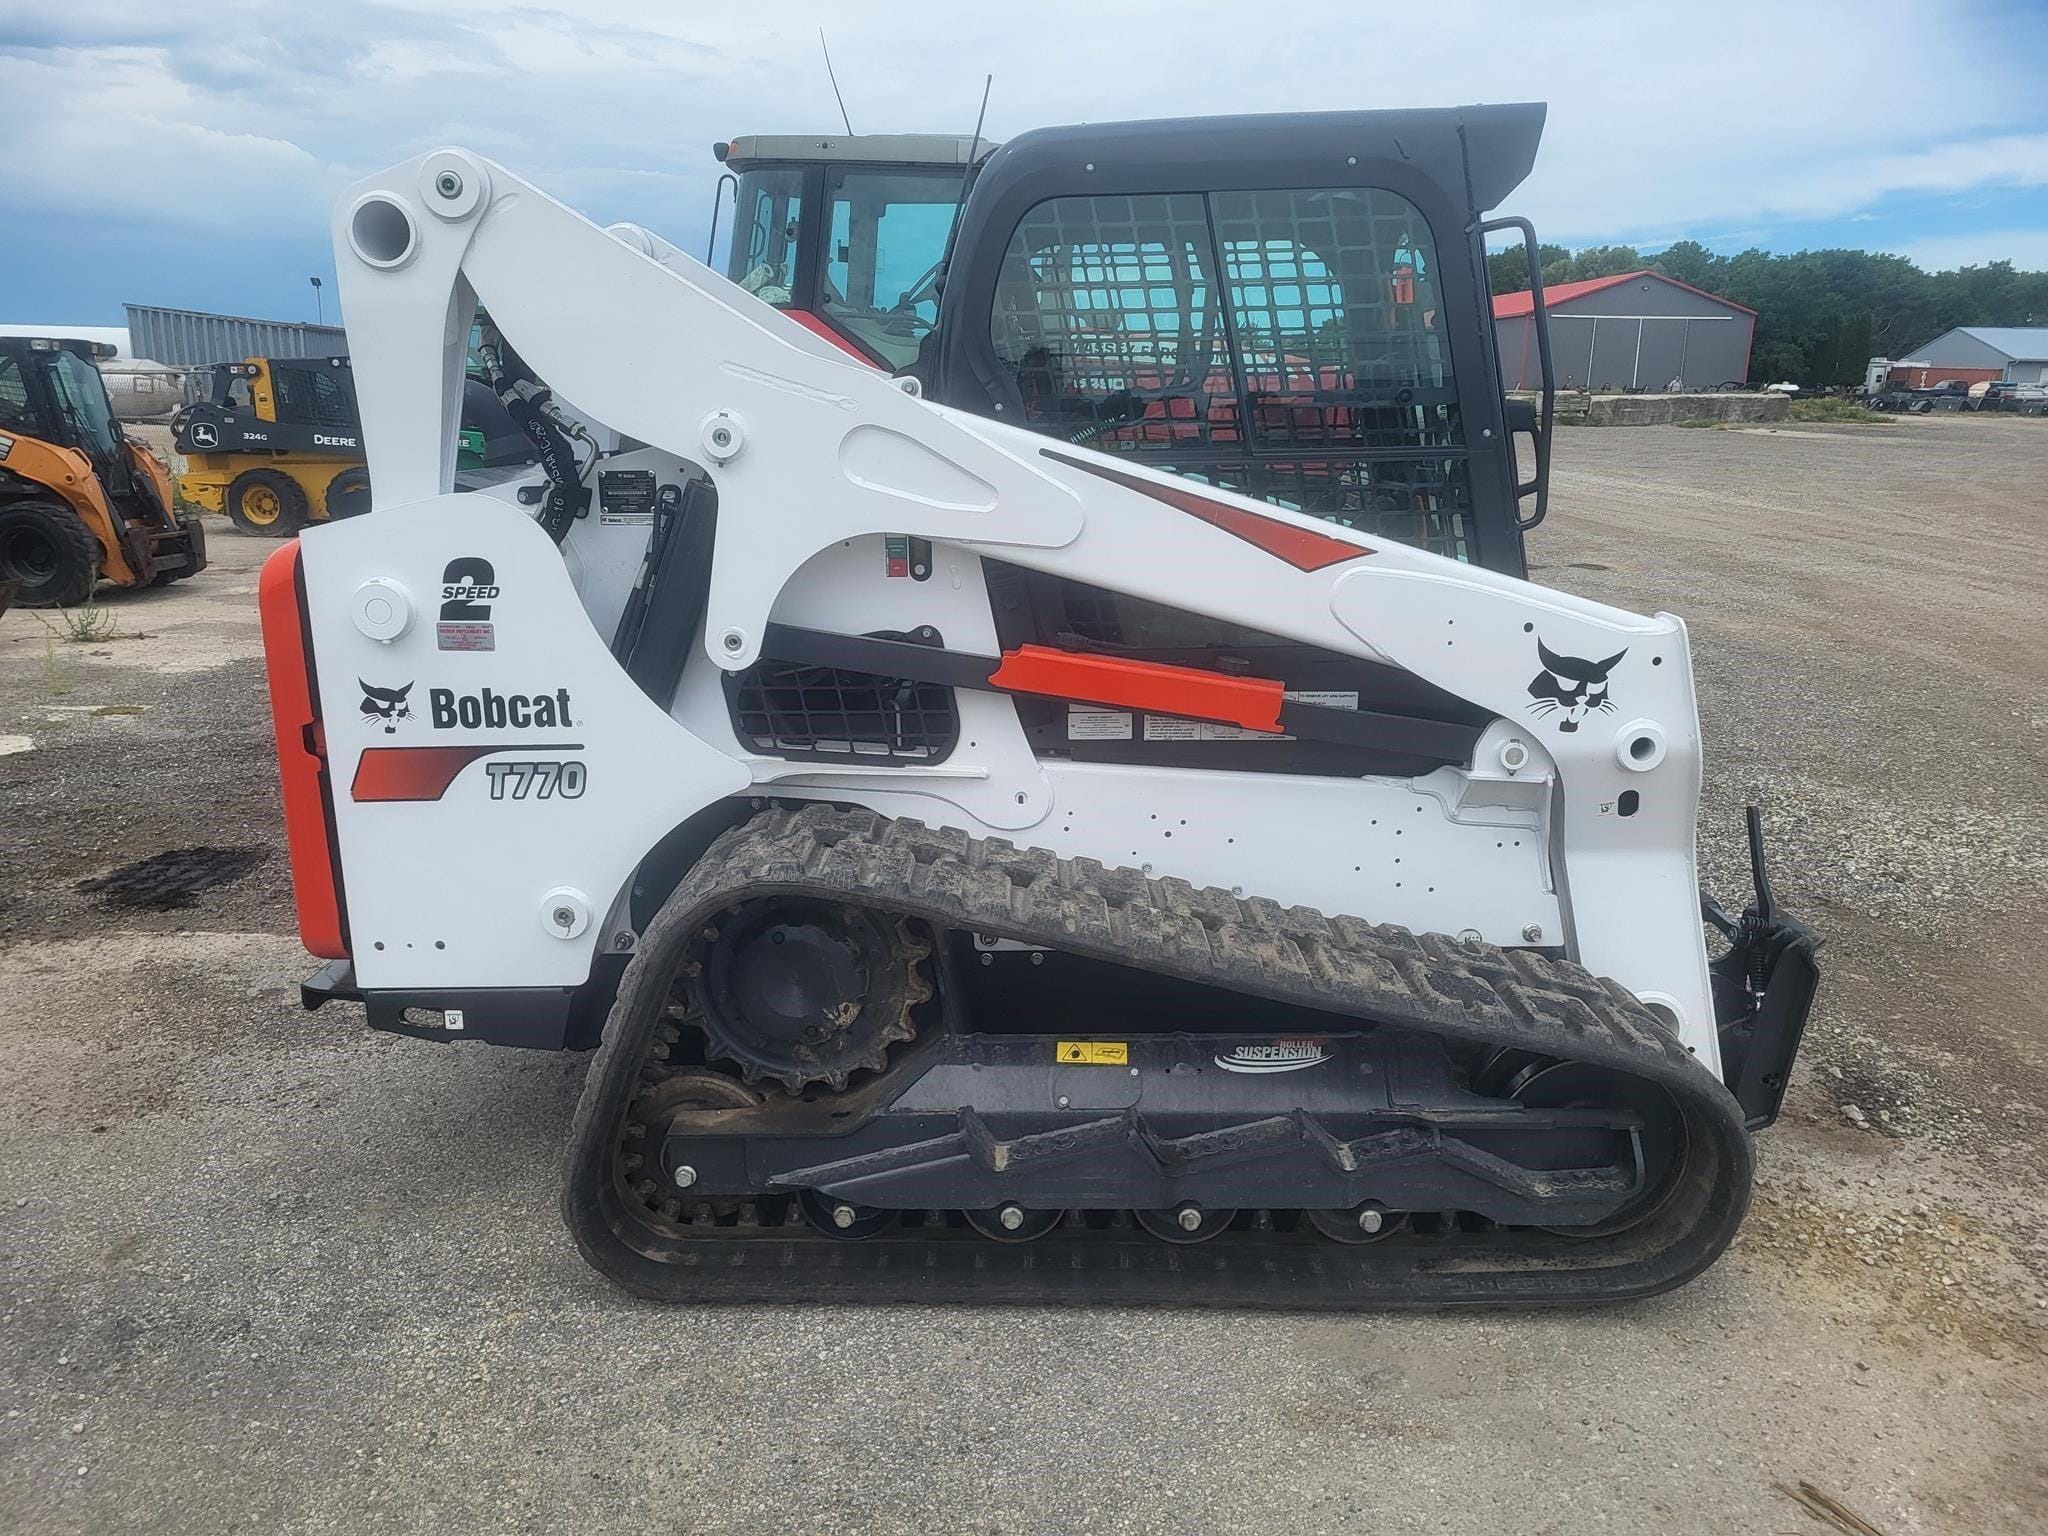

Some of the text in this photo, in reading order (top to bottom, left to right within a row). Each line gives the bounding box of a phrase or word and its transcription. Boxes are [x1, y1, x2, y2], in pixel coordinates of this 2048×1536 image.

[243, 432, 268, 441] 324G
[314, 434, 356, 446] DEERE
[440, 557, 494, 621] 2
[441, 586, 500, 599] SPEED
[429, 687, 573, 730] Bobcat
[486, 761, 588, 801] T770
[1280, 1040, 1314, 1049] ROLLER
[1234, 1046, 1322, 1059] SUSPENSION
